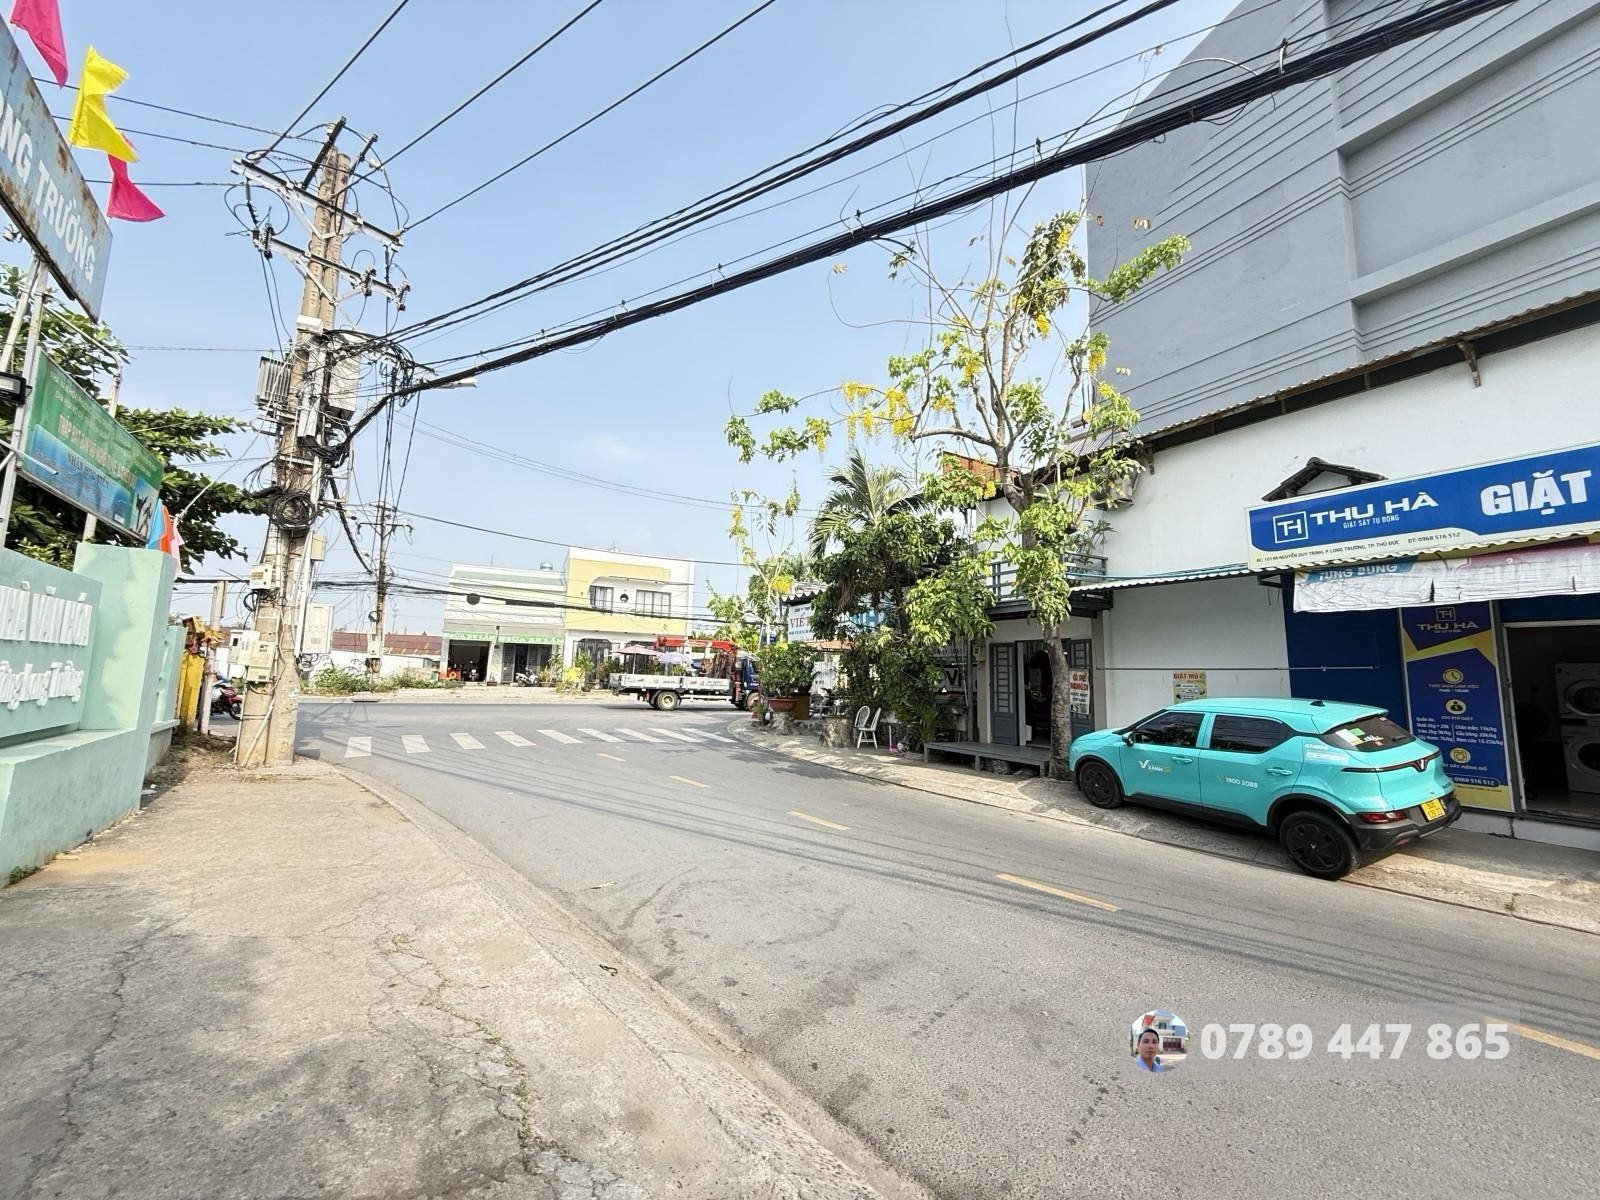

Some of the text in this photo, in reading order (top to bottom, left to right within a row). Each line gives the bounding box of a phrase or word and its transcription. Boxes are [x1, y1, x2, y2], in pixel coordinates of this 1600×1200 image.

[0, 88, 97, 285] NG TRƯỜNG
[1309, 491, 1439, 526] THU HÀ
[1480, 469, 1592, 516] GIẶT
[1381, 514, 1400, 524] ĐỘNG
[1416, 622, 1451, 632] THU
